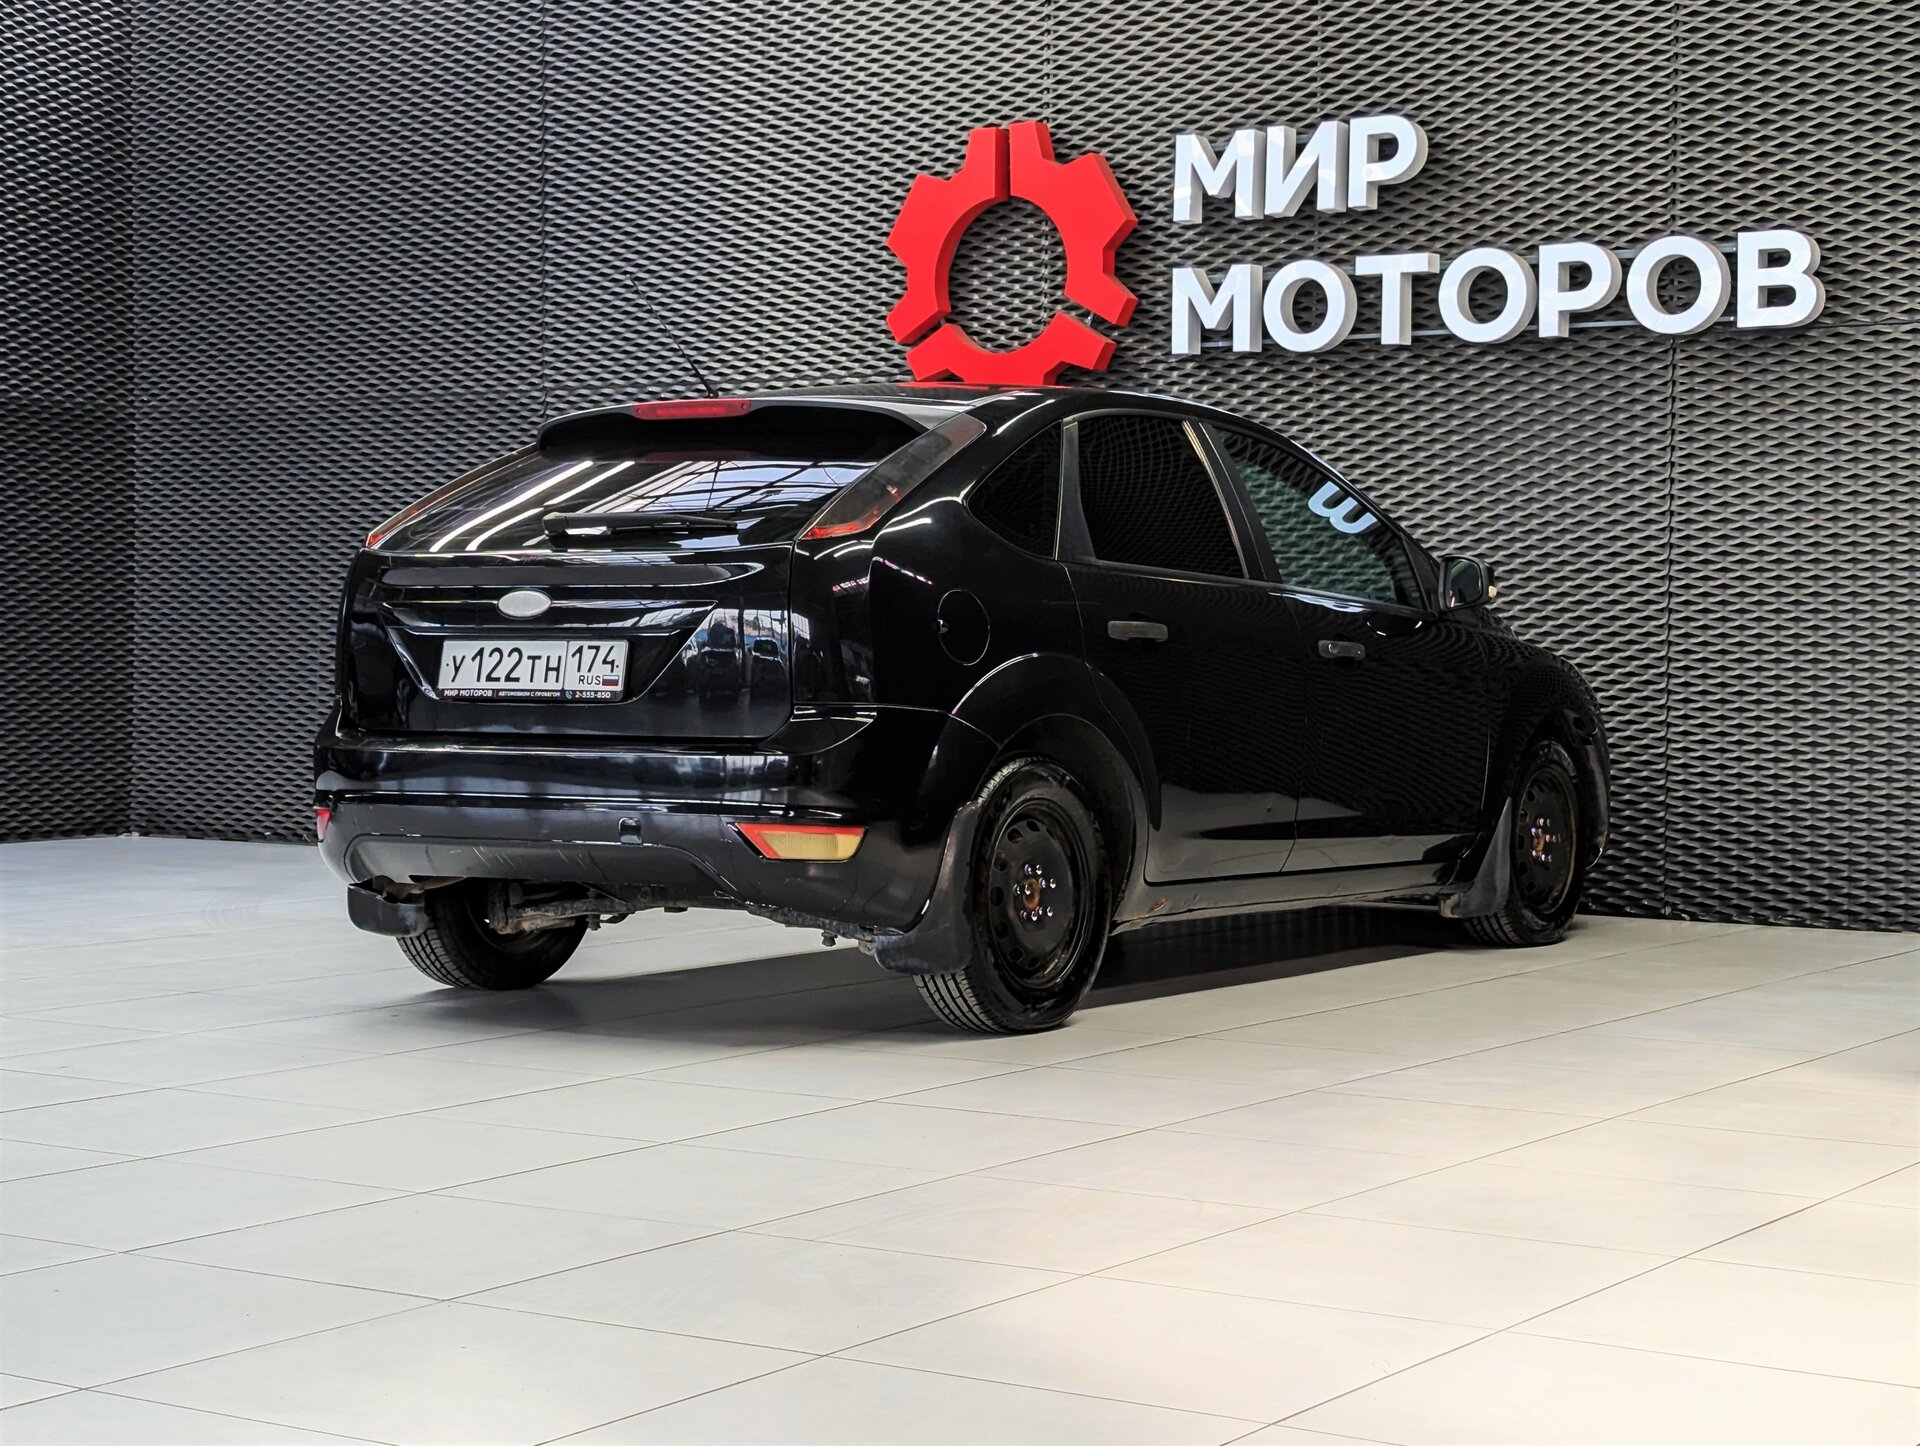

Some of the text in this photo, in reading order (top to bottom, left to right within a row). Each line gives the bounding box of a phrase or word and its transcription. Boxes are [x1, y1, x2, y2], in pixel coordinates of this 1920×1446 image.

[1173, 114, 1429, 224] МИР
[1171, 229, 1826, 356] МОТОРОВ
[571, 645, 616, 673] 174
[578, 675, 601, 686] RUS
[443, 689, 493, 697] МИР МОТОРОВ
[574, 691, 611, 699] 2-555-850
